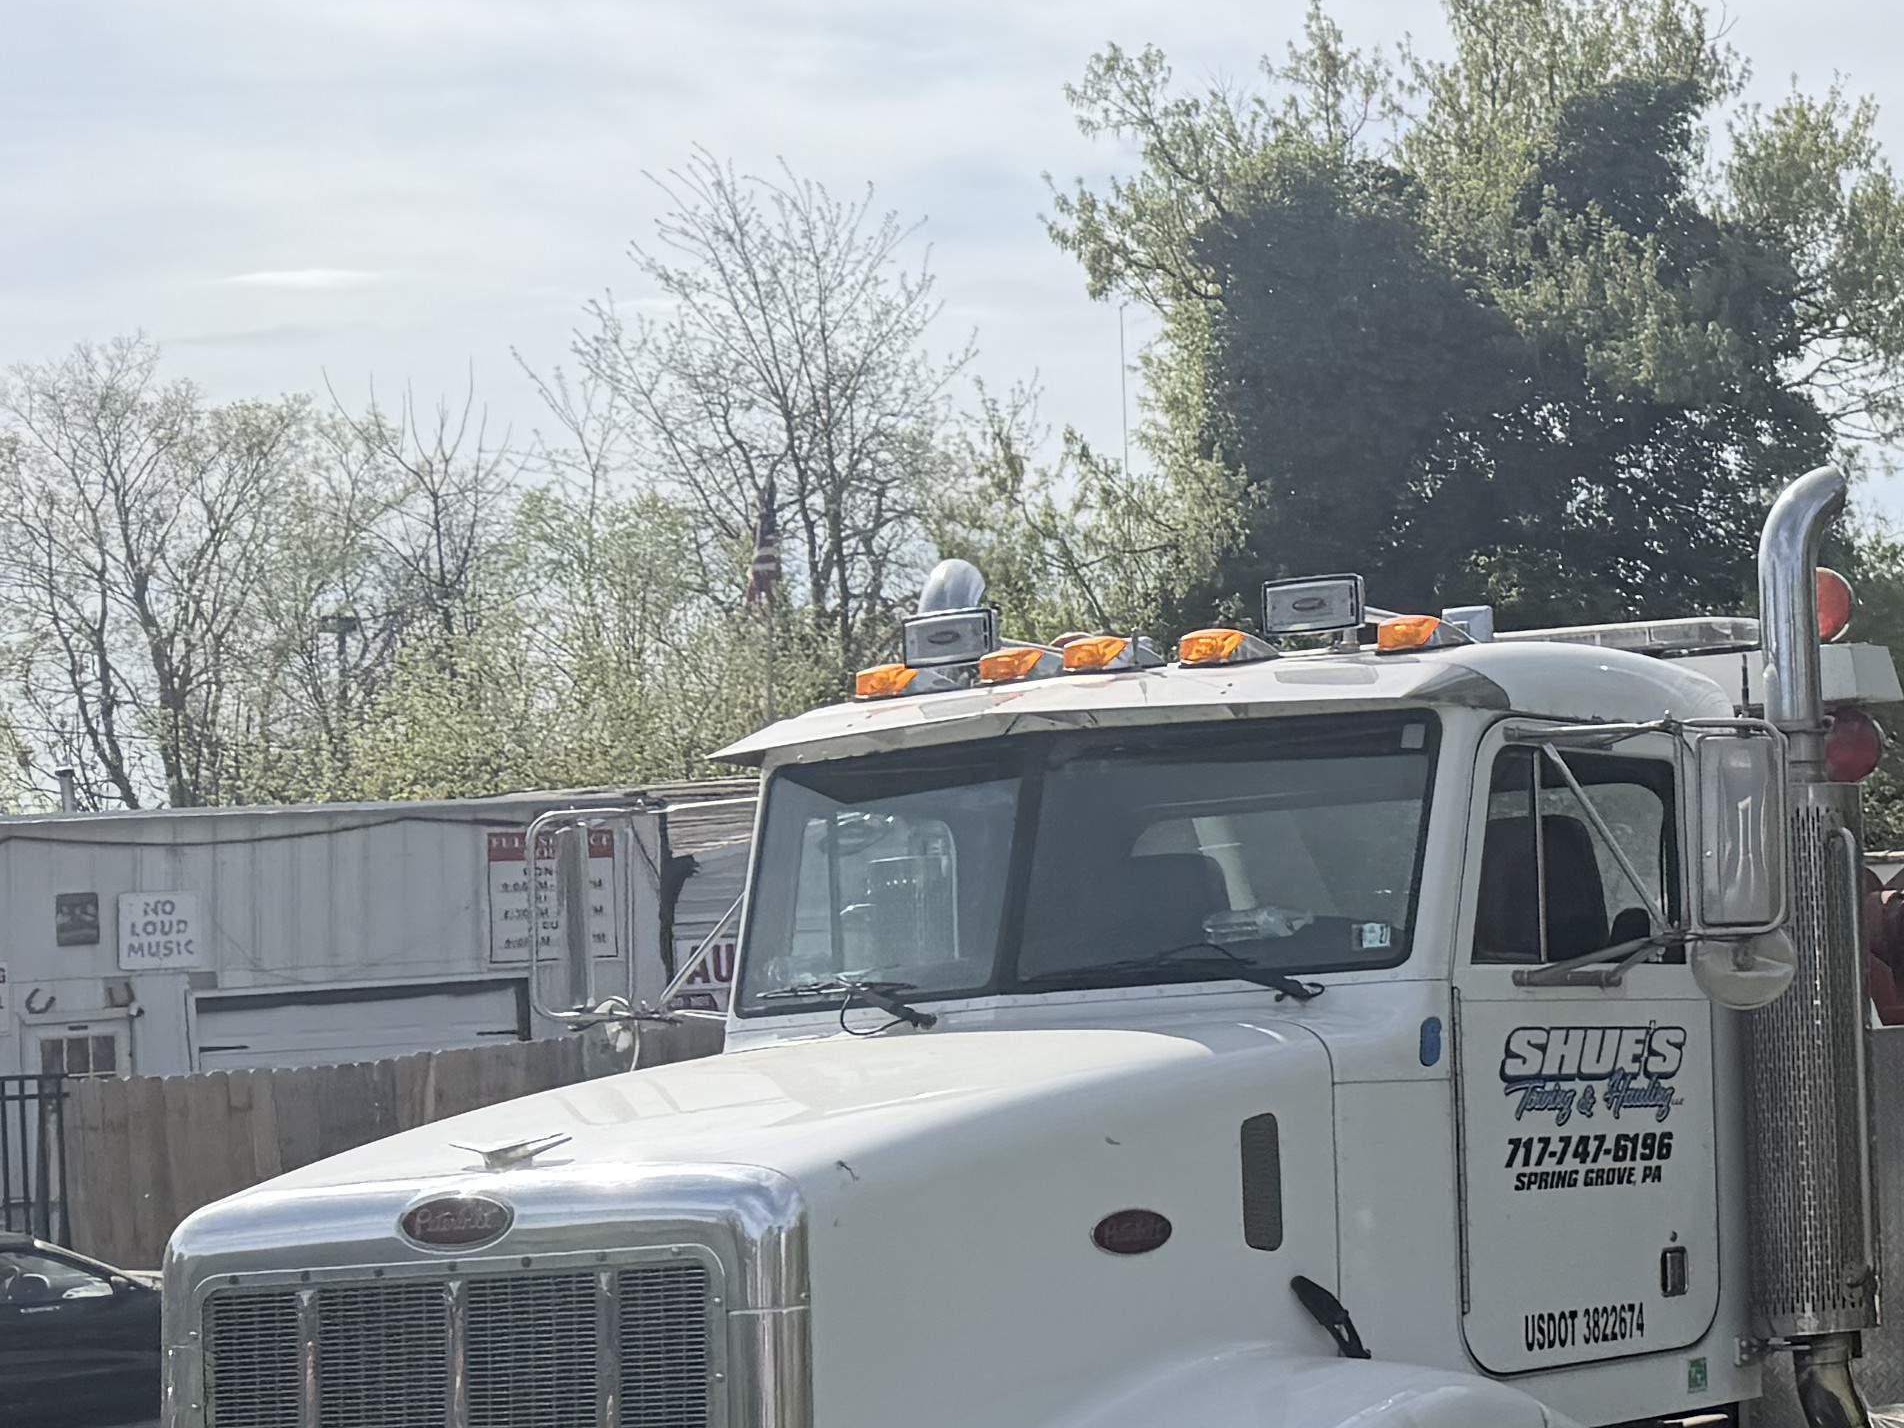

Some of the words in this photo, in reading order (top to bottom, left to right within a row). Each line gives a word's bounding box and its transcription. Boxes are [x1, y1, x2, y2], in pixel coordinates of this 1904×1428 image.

[143, 899, 176, 916] NO
[130, 920, 188, 937] LOUD
[127, 940, 195, 958] MUSIC
[1504, 1079, 1577, 1126] Towing
[1577, 1084, 1597, 1118] &
[1603, 1068, 1676, 1123] Hauling
[1505, 1132, 1674, 1168] 717-747-6196
[1514, 1169, 1580, 1191] SPRING
[1583, 1166, 1637, 1186] GROVE,
[1641, 1165, 1663, 1184] PA
[1525, 1310, 1578, 1352] USDOT
[1583, 1301, 1645, 1344] 3822674
